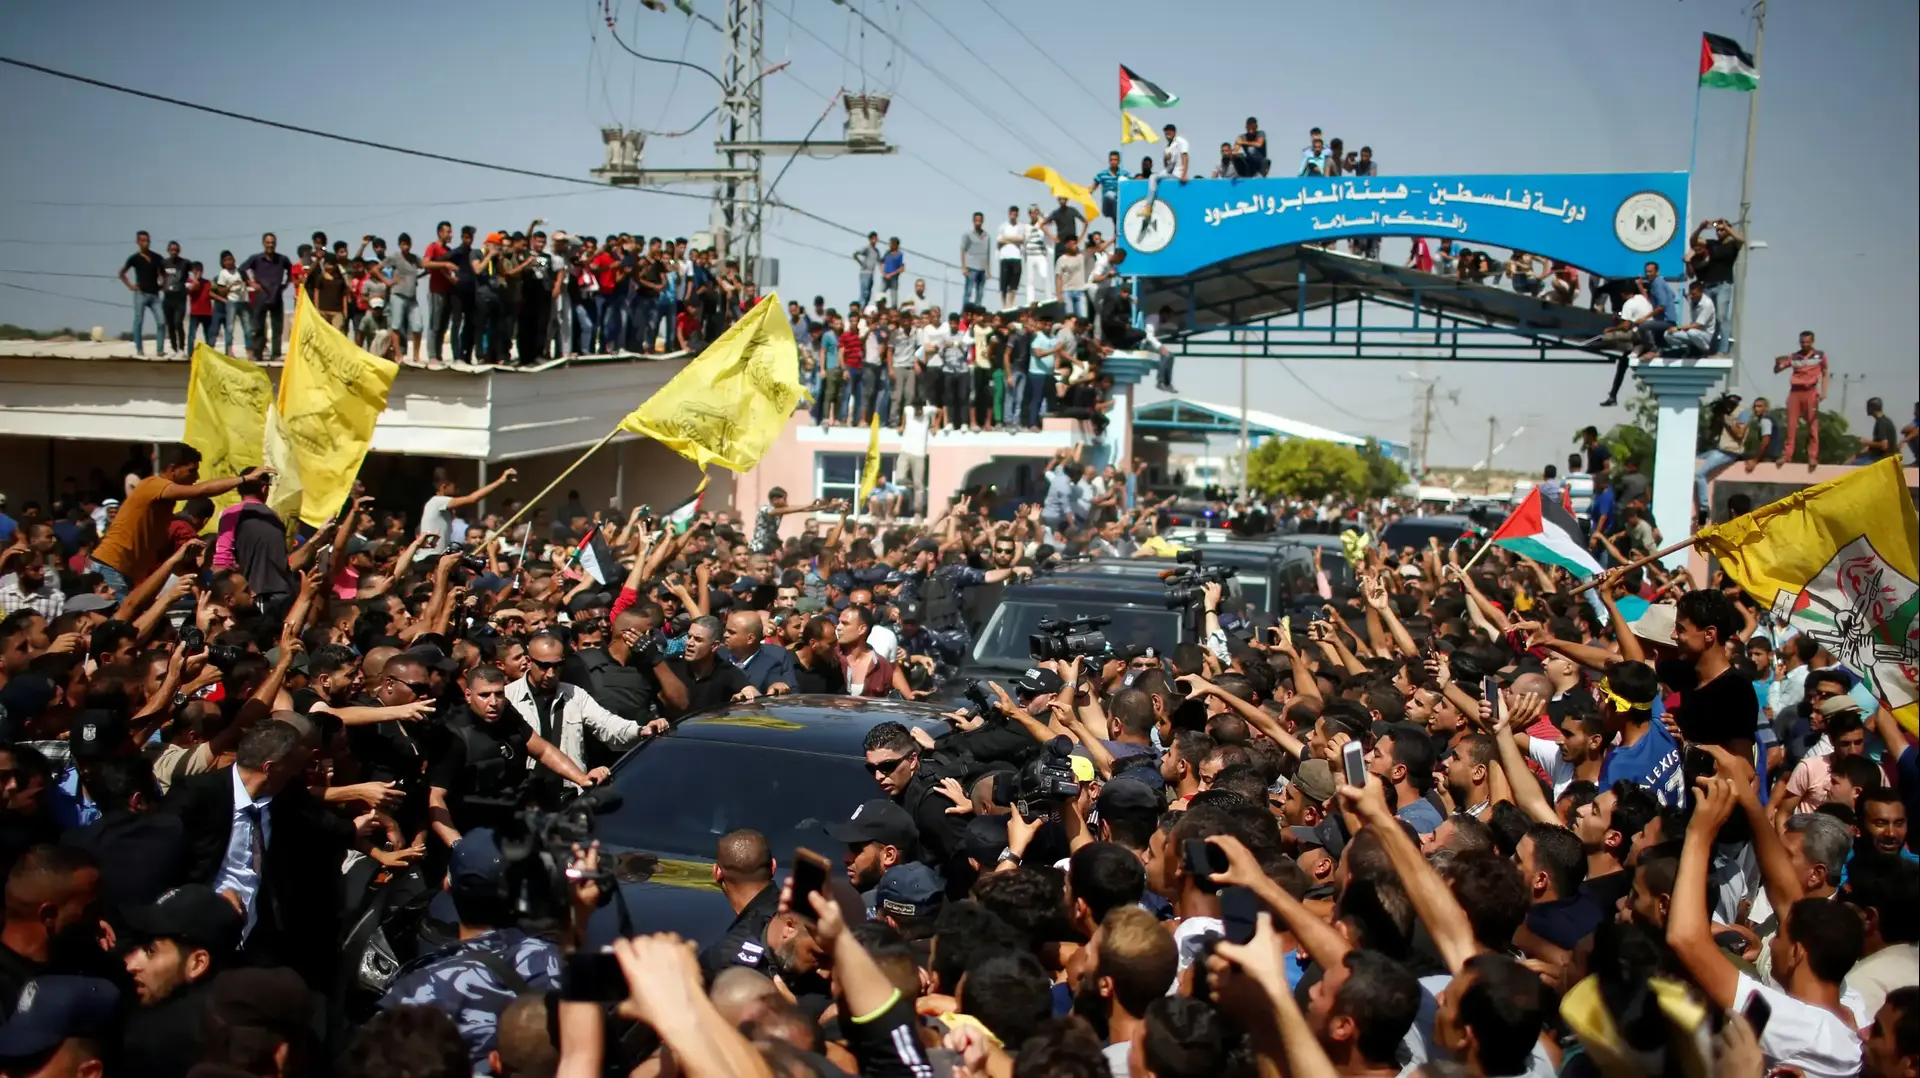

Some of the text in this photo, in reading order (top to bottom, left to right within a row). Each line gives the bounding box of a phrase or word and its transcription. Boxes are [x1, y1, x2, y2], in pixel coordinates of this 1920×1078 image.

[1276, 182, 1344, 213] المعابر
[1344, 179, 1408, 204] هيئة
[1428, 181, 1532, 211] فلسطين
[1204, 193, 1276, 226] والحدود
[1311, 210, 1467, 233] رافقتكم السلامة
[1532, 191, 1587, 224] دولة
